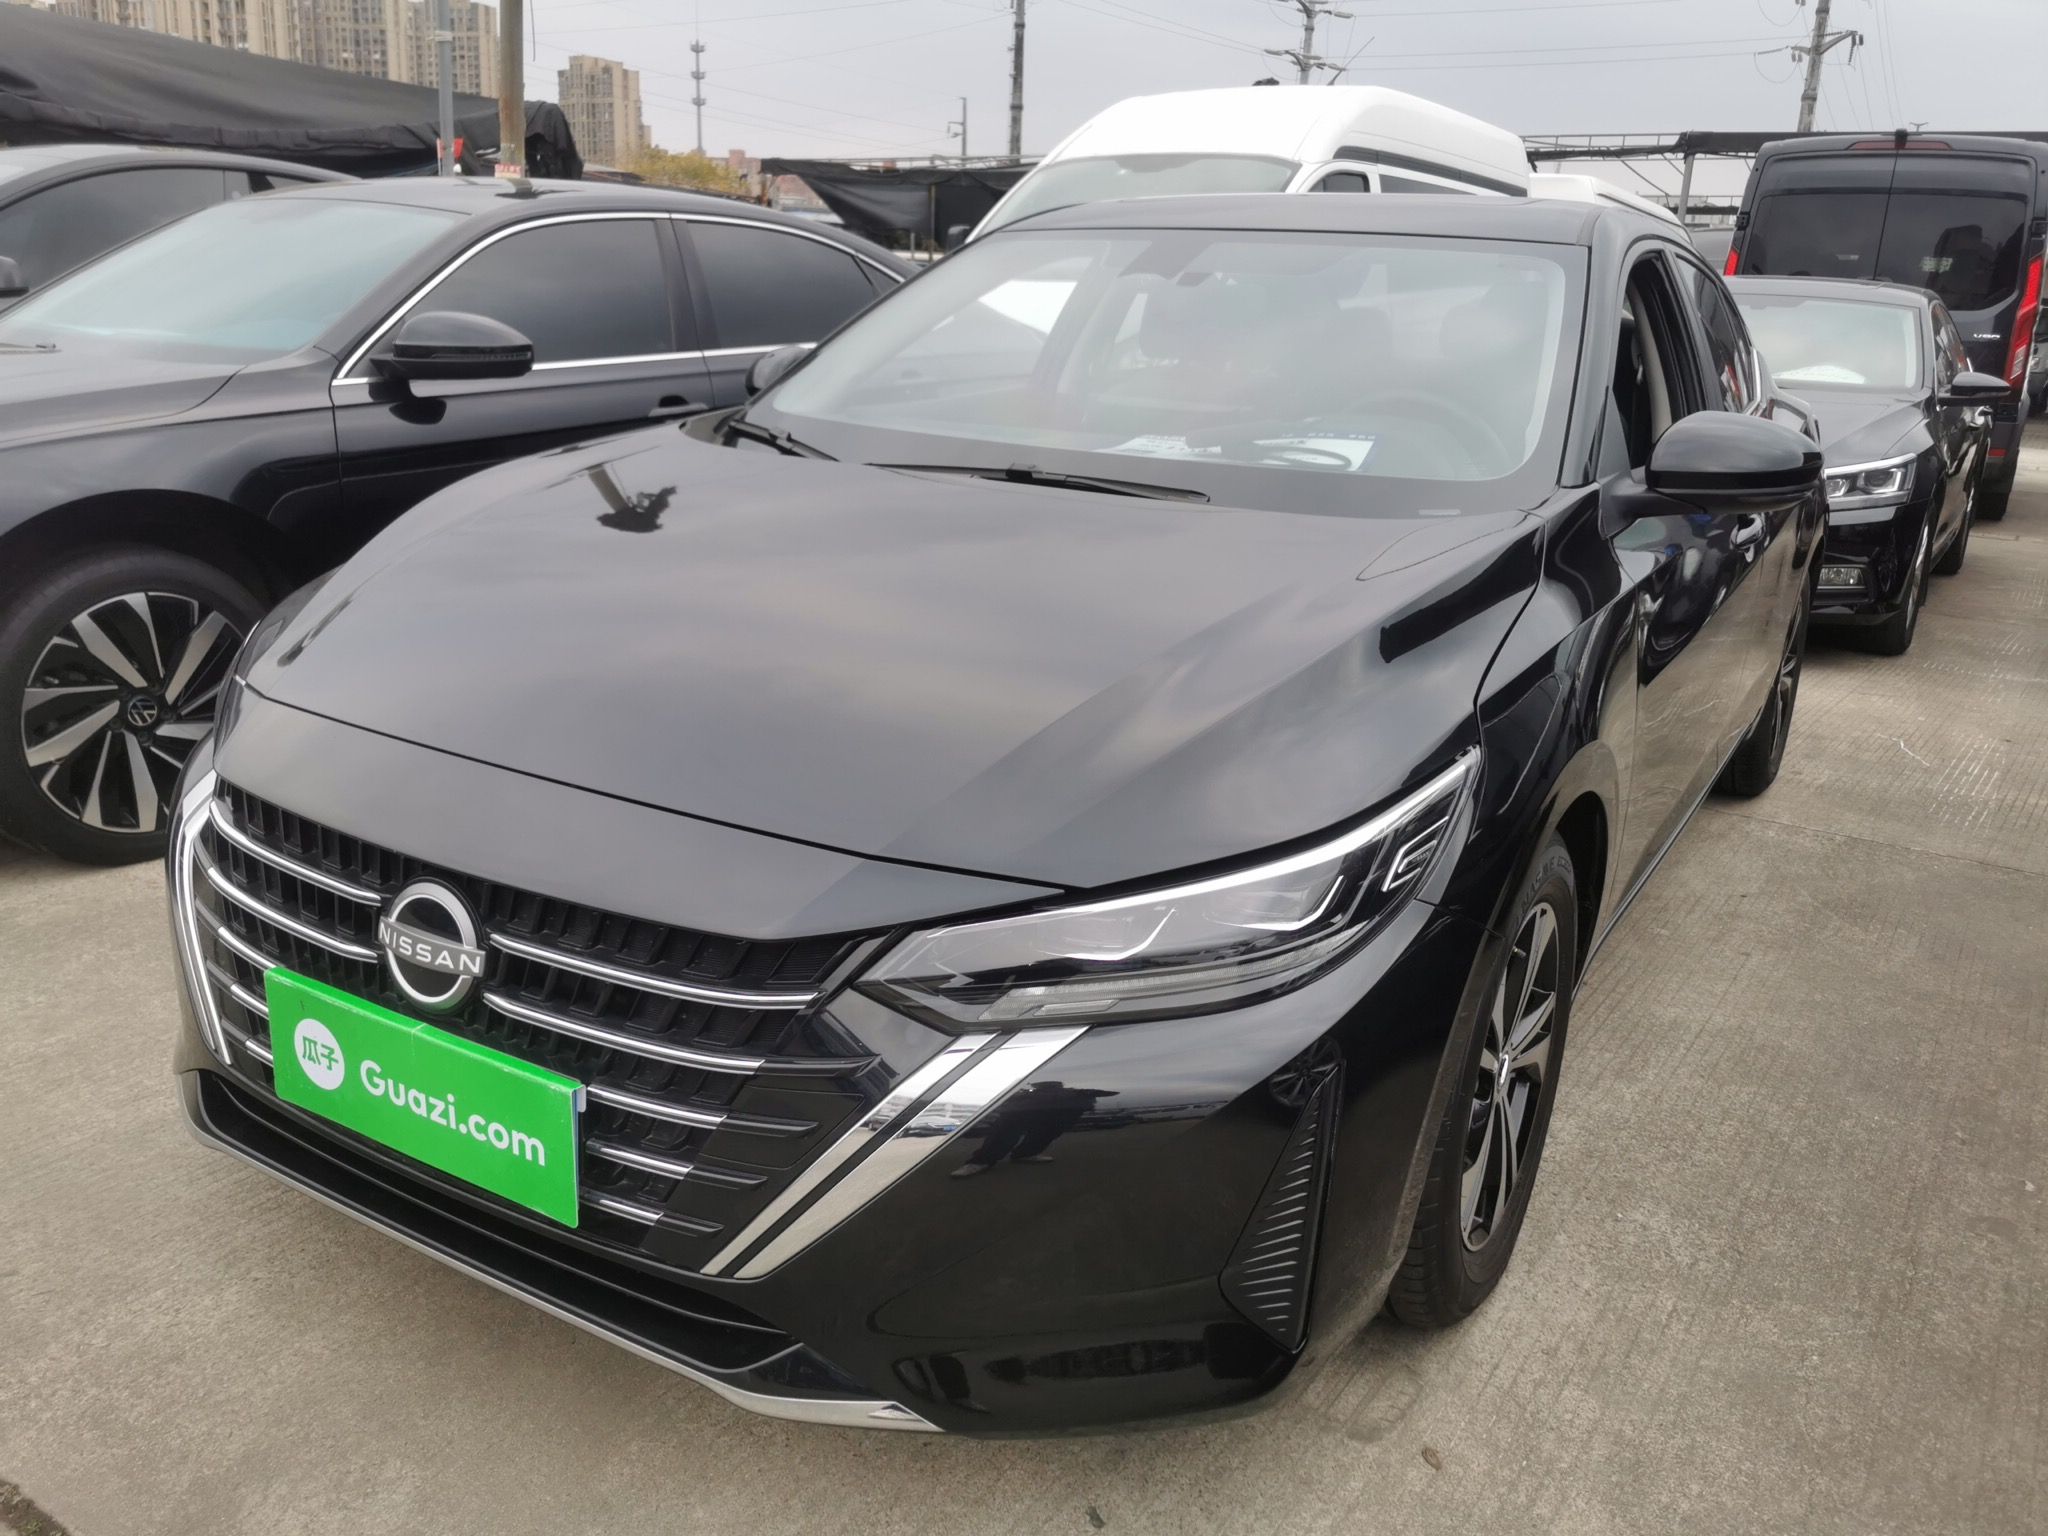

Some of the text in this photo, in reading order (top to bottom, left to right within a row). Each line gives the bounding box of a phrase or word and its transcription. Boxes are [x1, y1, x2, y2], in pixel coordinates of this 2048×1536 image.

[379, 922, 481, 974] NISSAN
[302, 1036, 339, 1071] 瓜子
[360, 1060, 545, 1166] Guazi.com
